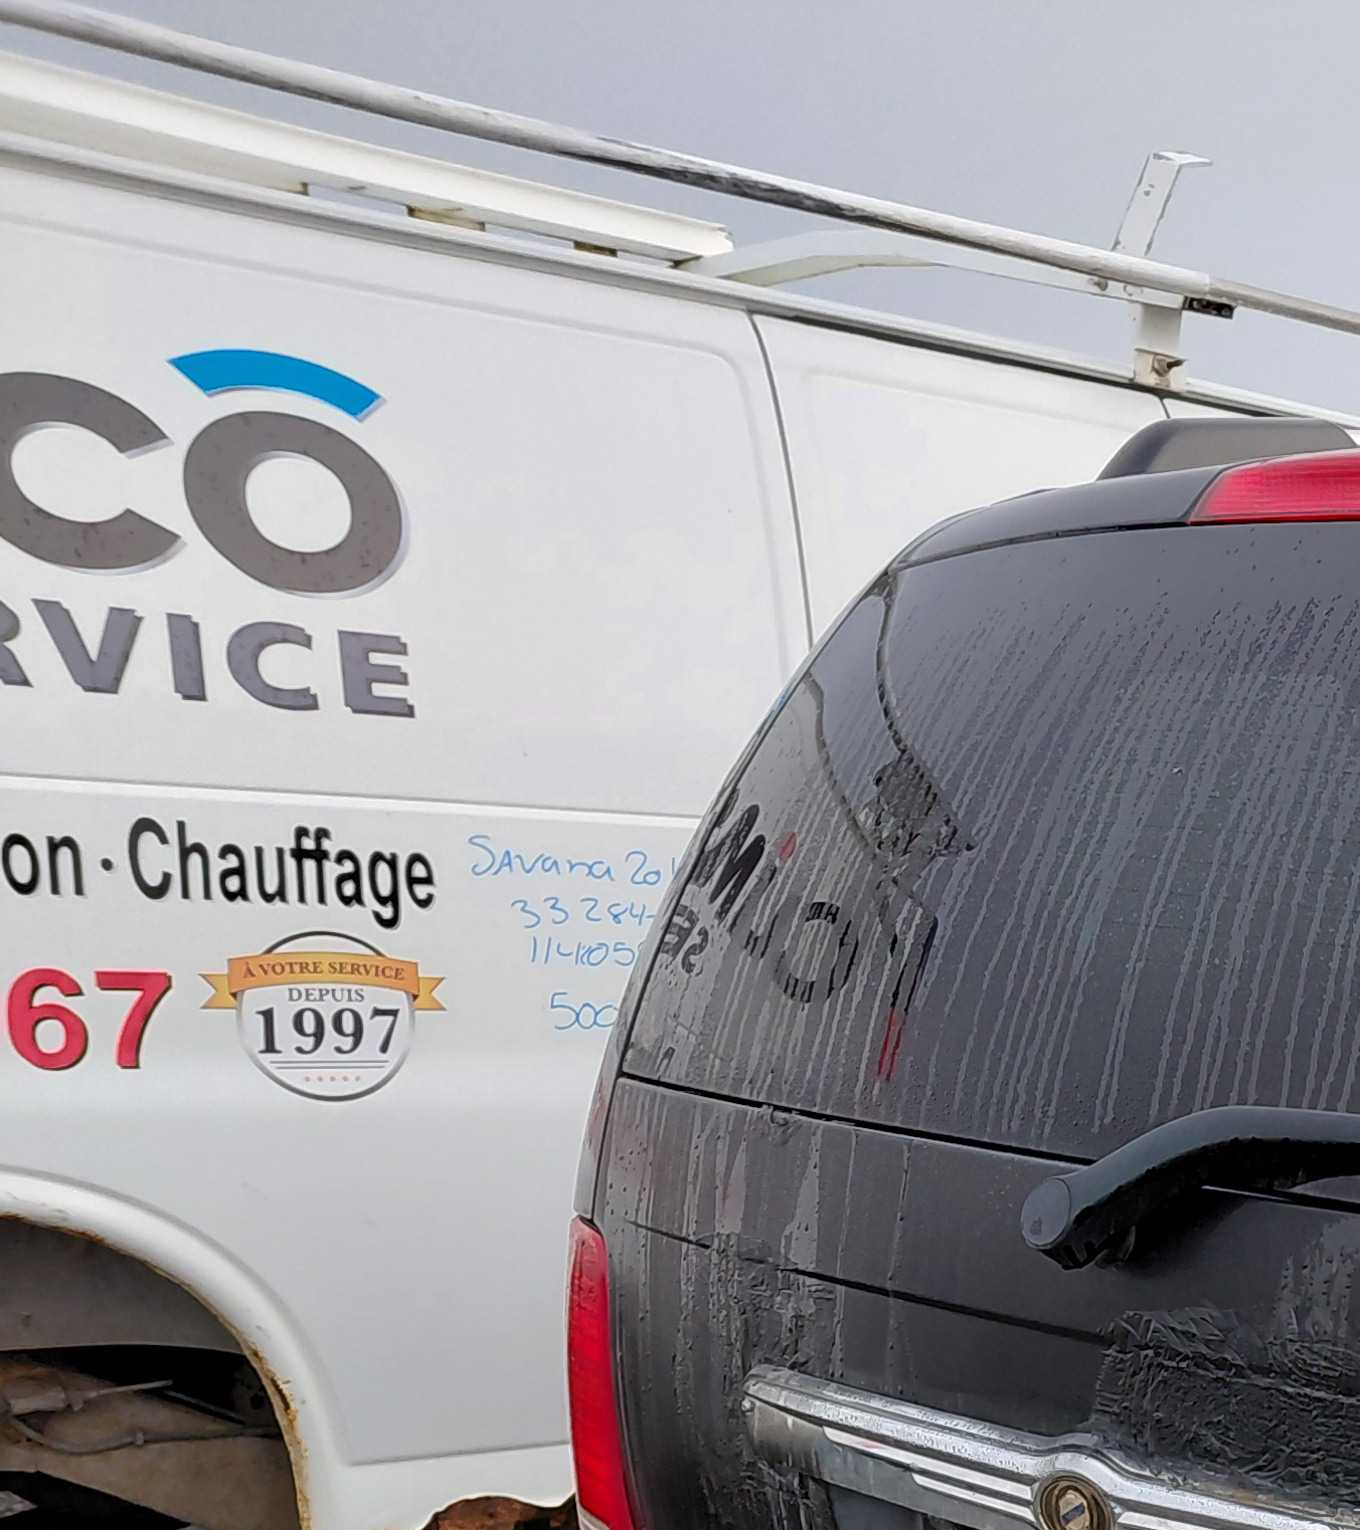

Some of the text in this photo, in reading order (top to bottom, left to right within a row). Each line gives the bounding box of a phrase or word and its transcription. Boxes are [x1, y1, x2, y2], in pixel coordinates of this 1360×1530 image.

[127, 816, 438, 930] Chauffage
[242, 961, 406, 981] À VOTRE SERVICE
[287, 987, 366, 1003] DEPUIS
[7, 966, 173, 1072] 67
[254, 1005, 401, 1055] 1997
